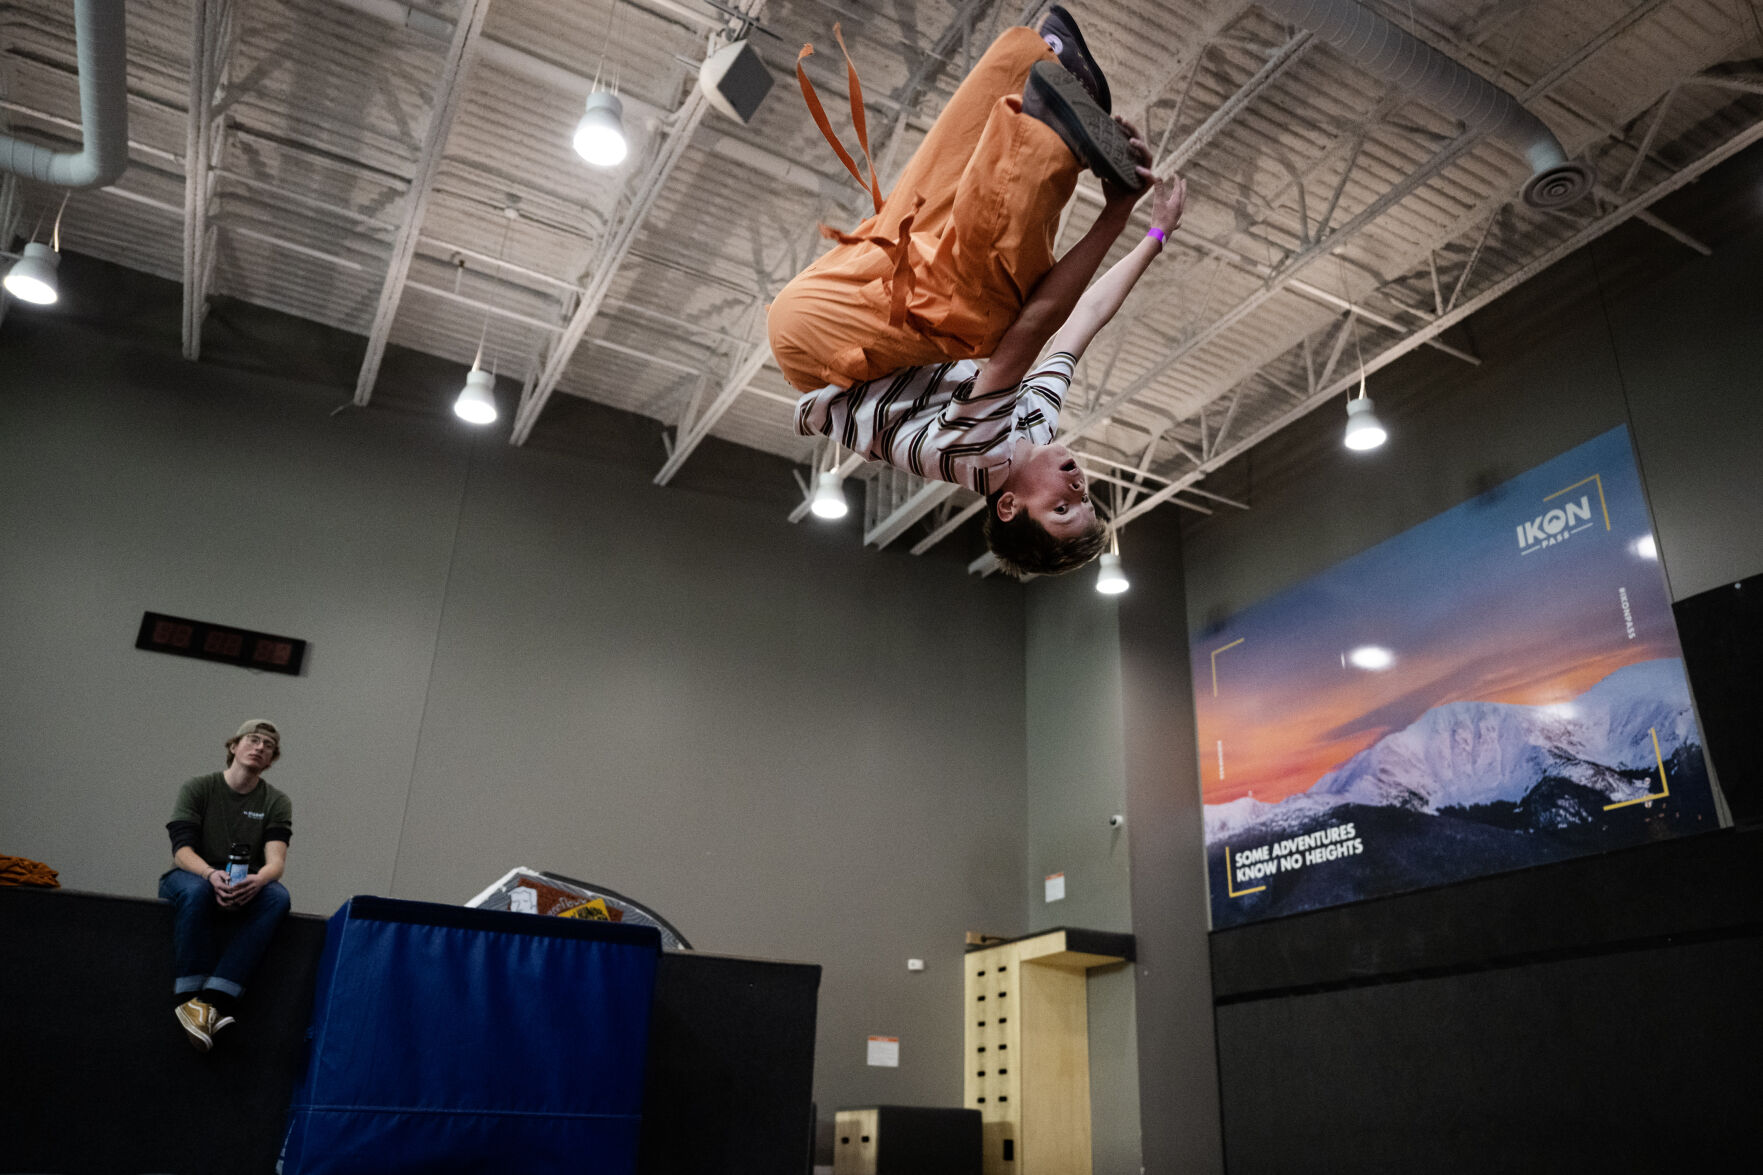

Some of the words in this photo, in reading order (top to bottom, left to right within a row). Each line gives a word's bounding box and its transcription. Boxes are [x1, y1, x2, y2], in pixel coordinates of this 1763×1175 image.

[1516, 495, 1592, 549] IKON
[1541, 530, 1570, 549] PASS
[1235, 845, 1270, 867] SOME
[1272, 822, 1356, 858] ADVENTURES
[1236, 859, 1278, 883] KNOW
[1280, 853, 1303, 872] NO
[1305, 837, 1364, 866] HEIGHTS
